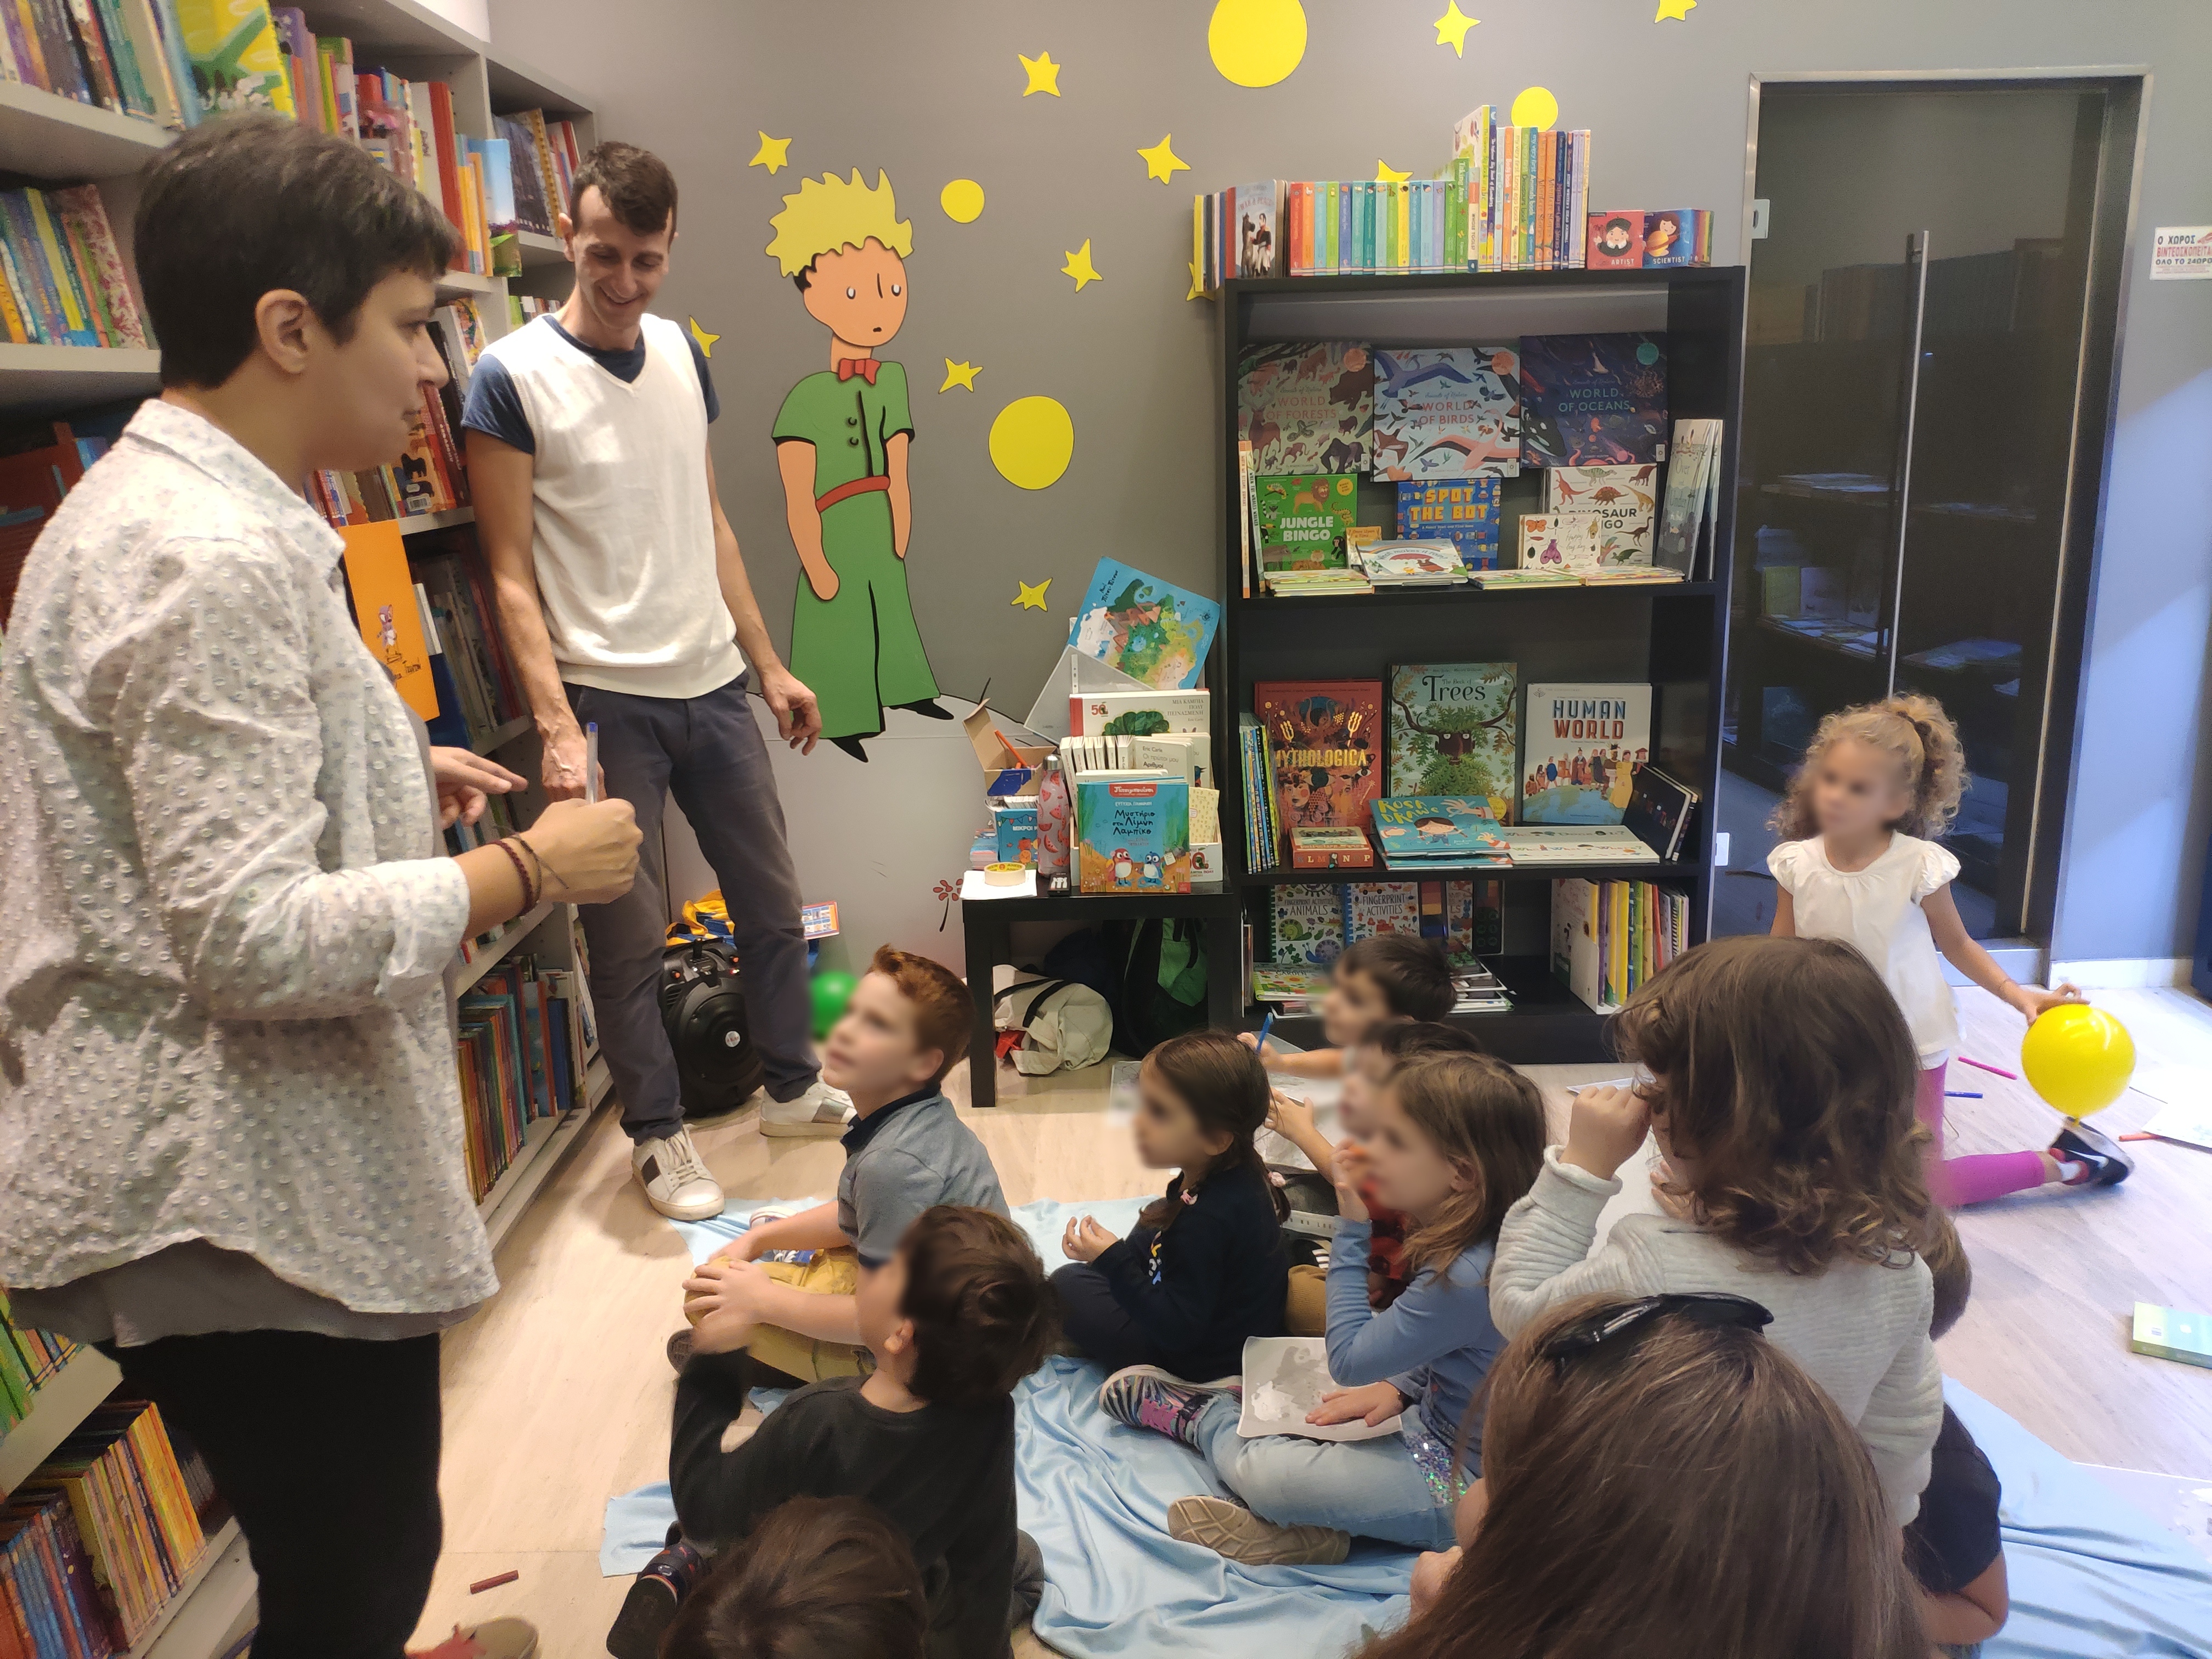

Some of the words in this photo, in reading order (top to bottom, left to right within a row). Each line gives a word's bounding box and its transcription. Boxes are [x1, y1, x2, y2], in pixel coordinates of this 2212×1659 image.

[1457, 161, 1466, 188] Taking
[2157, 235, 2164, 245] Ο
[2167, 235, 2196, 245] ΧΩΡΟΣ
[1652, 256, 1685, 264] SCIENTIST
[1569, 387, 1619, 399] WORLD
[1277, 396, 1325, 407] WORLD
[1423, 400, 1471, 411] WORLD
[1558, 402, 1575, 413] OF
[1578, 400, 1630, 411] OCEANS
[1266, 410, 1282, 421] OF
[1285, 409, 1336, 420] FORESTS
[1419, 415, 1435, 425] OF
[1439, 414, 1474, 425] BIRDS
[1424, 488, 1474, 504] SPOT
[1409, 506, 1444, 522] THE
[1452, 504, 1488, 520] BOT
[1568, 507, 1637, 518] SAUR
[1279, 516, 1334, 530] JUNGLE
[1283, 529, 1331, 542] BINGO
[1565, 533, 1583, 543] Happy
[1576, 543, 1585, 552] day
[1422, 674, 1486, 702] Trees
[1552, 699, 1626, 720] HUMAN
[1554, 719, 1624, 740] WORLD
[1378, 799, 1427, 813] ROSA
[1114, 809, 1155, 821] Μυστήριο
[1125, 816, 1154, 829] Λίμνη
[1113, 826, 1152, 837] Λαμπίκο
[1342, 855, 1351, 863] N
[1362, 893, 1406, 905] FINGERPRINT
[1290, 905, 1328, 916] ANIMALS
[1366, 904, 1403, 916] ACTIVITIES
